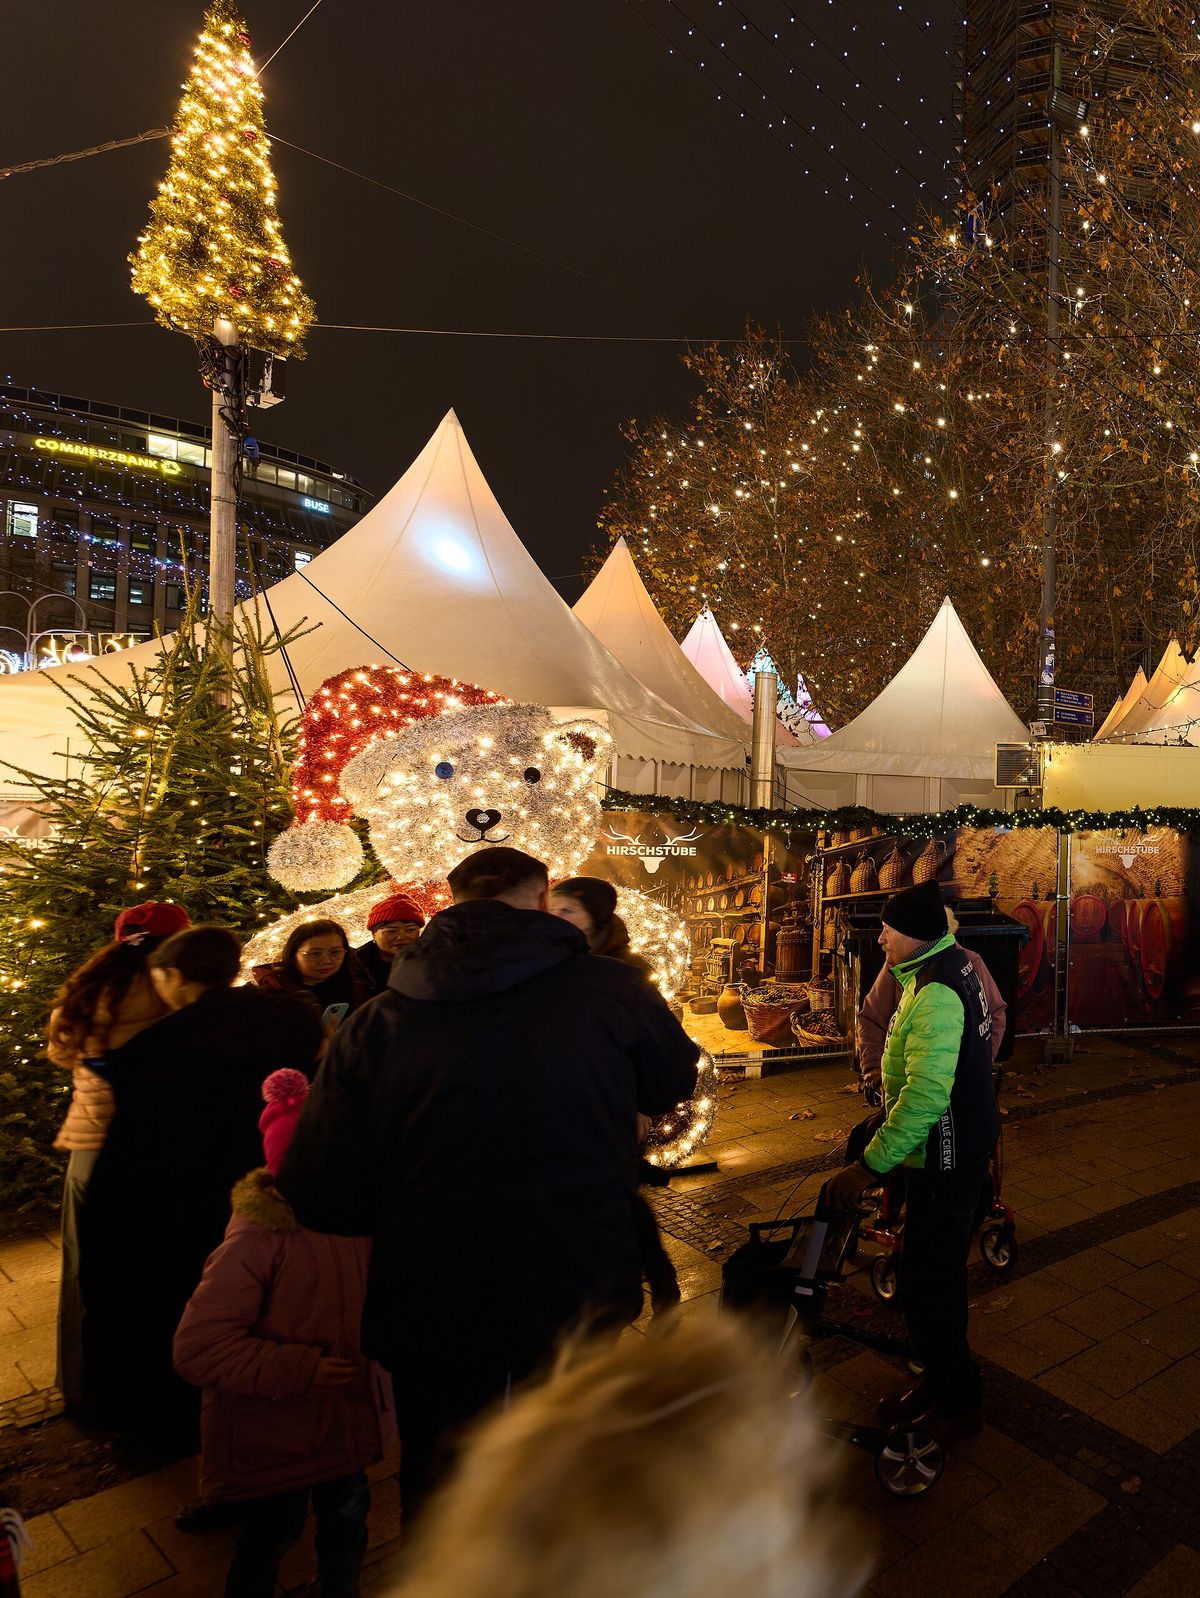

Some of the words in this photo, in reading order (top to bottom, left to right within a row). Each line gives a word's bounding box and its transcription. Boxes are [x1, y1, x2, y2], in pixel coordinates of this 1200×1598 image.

[34, 438, 158, 469] COMMERZBANK
[304, 498, 330, 513] BUSE
[606, 845, 697, 856] HIRSCHSTUBE
[1095, 846, 1160, 854] HIRSCHSTUBE
[941, 1115, 951, 1137] BLUE
[942, 1139, 952, 1165] CREW
